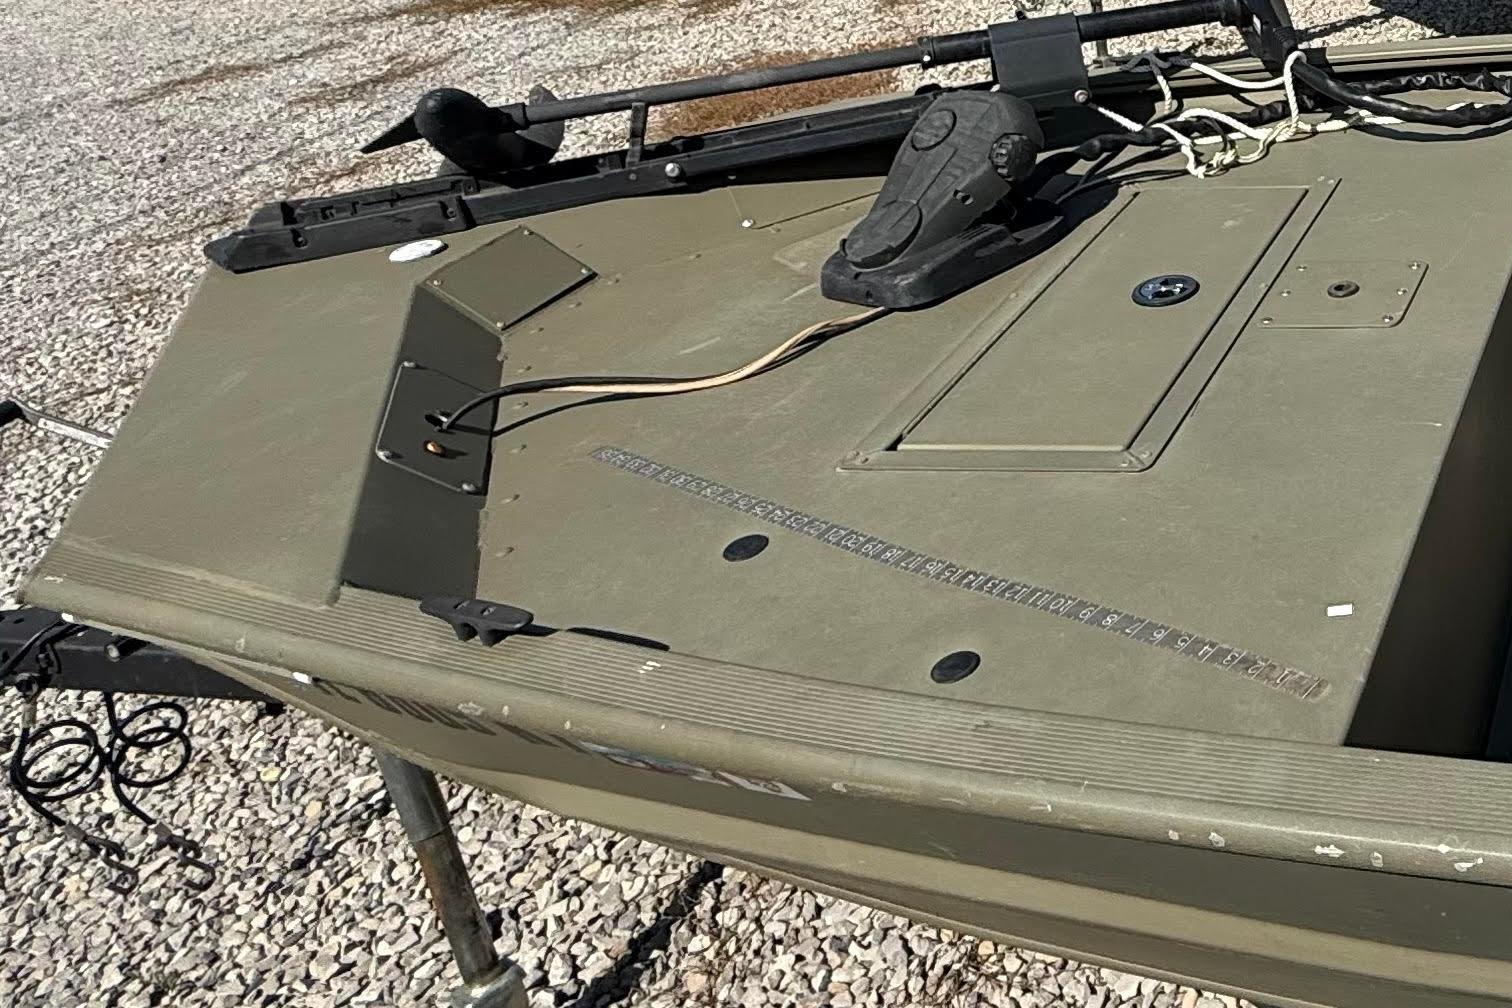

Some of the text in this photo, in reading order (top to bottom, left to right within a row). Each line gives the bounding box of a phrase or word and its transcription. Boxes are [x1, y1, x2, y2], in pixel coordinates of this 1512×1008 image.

[983, 580, 1006, 592] 13
[1005, 585, 1028, 598] 12
[1029, 592, 1049, 605] 11
[1050, 598, 1073, 612] 10
[1079, 607, 1095, 619] 9
[1102, 614, 1117, 625] 8
[1125, 623, 1140, 633] 7
[1149, 629, 1165, 640] 6
[1173, 636, 1189, 648] 5
[1198, 645, 1213, 656] 4
[1222, 652, 1238, 665] 3
[1248, 660, 1265, 674] 2
[1277, 669, 1289, 683] 1
